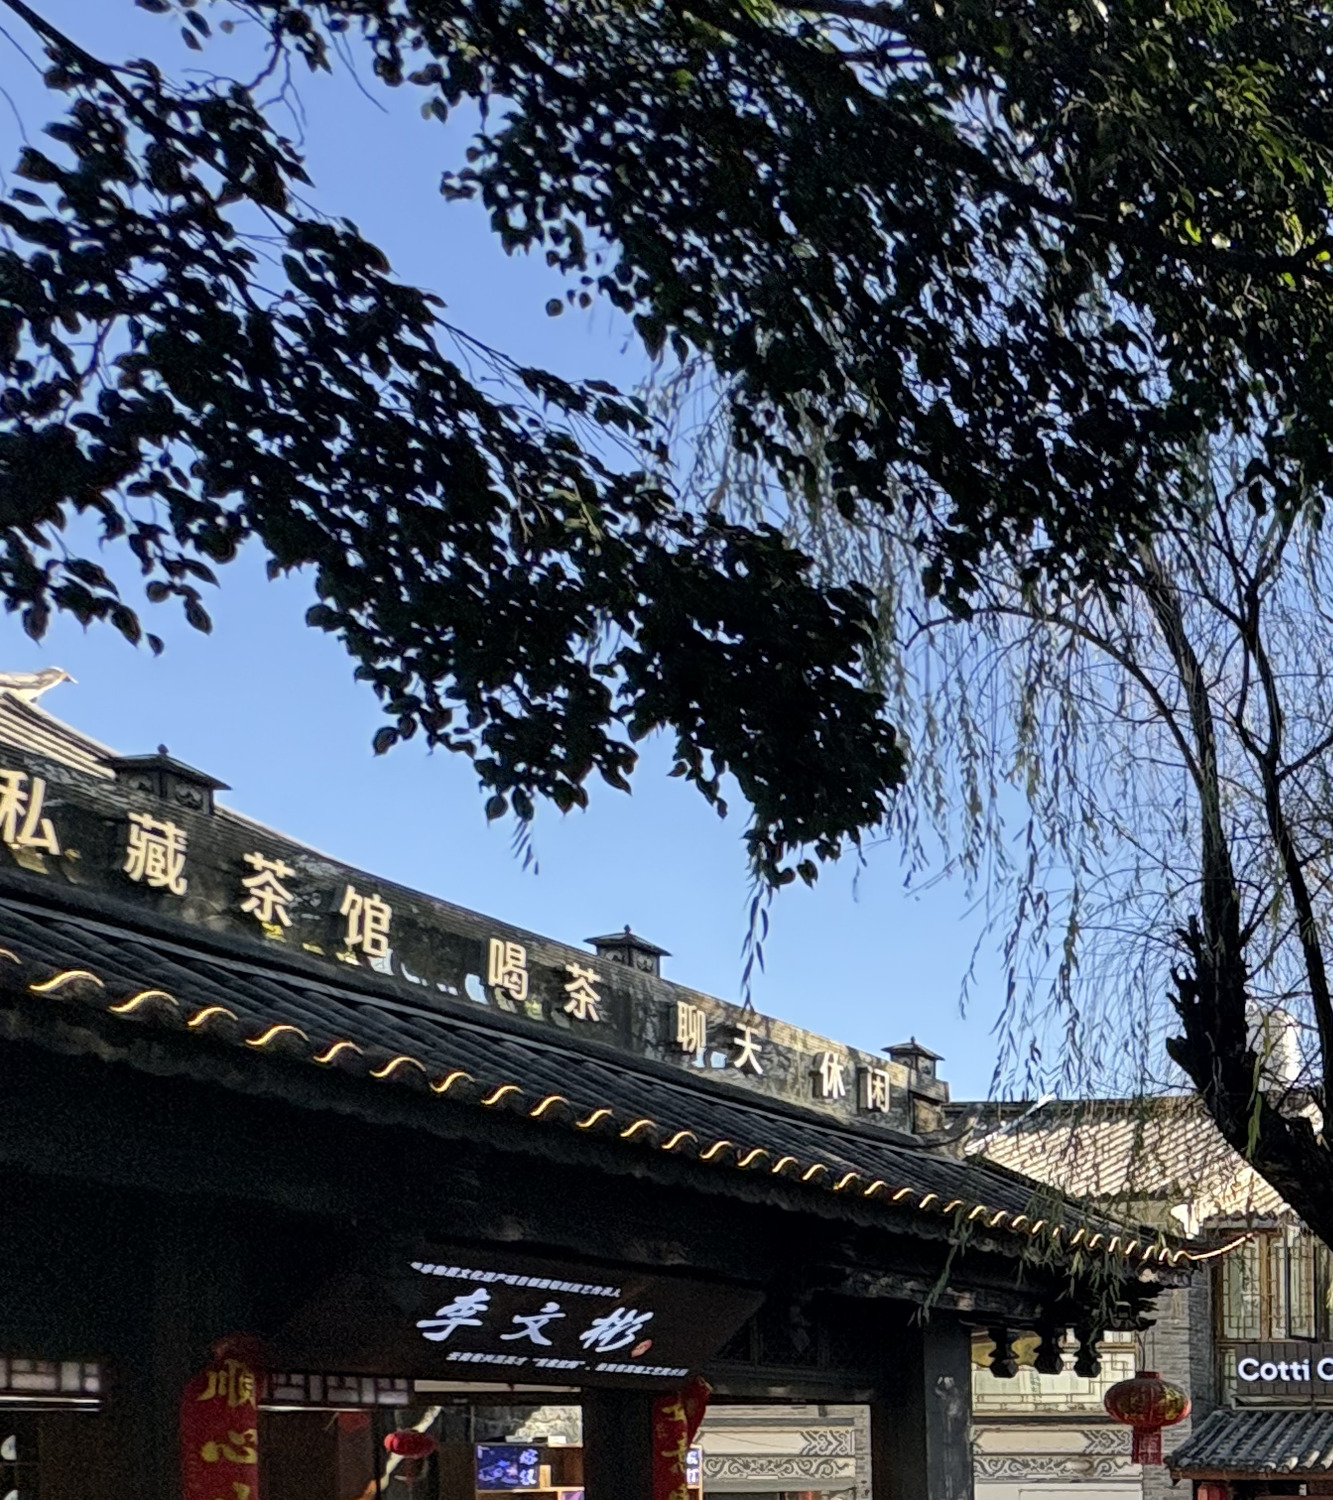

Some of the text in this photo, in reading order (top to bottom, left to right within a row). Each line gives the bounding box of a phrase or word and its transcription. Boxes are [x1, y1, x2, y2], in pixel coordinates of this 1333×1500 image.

[0, 769, 891, 1113] 私藏茶馆 喝茶 聊天 休闲
[416, 1287, 655, 1353] 李文彬
[1237, 1357, 1311, 1382] Cotti
